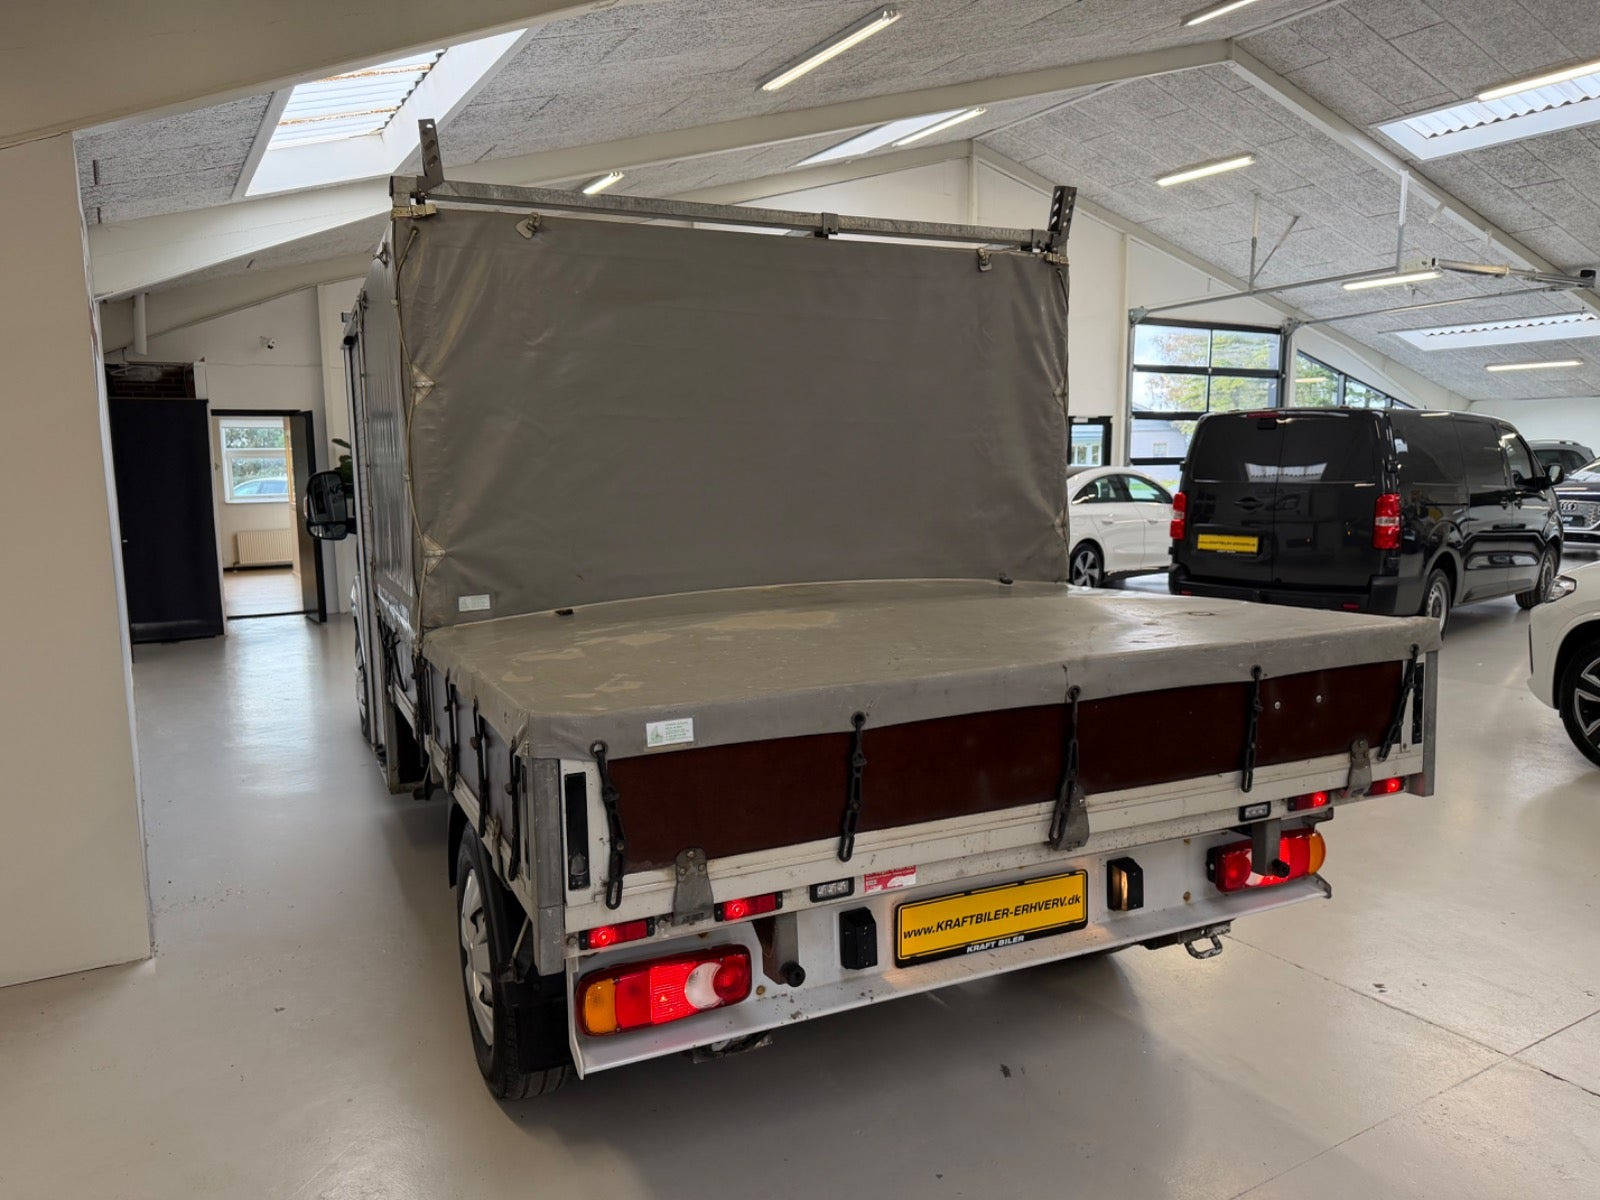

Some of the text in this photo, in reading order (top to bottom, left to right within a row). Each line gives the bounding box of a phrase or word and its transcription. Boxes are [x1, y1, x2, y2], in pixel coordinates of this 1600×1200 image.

[903, 894, 1081, 939] www.KRAFTBILER-ERHVERV.dk
[966, 935, 1025, 953] KRAFT BILER
